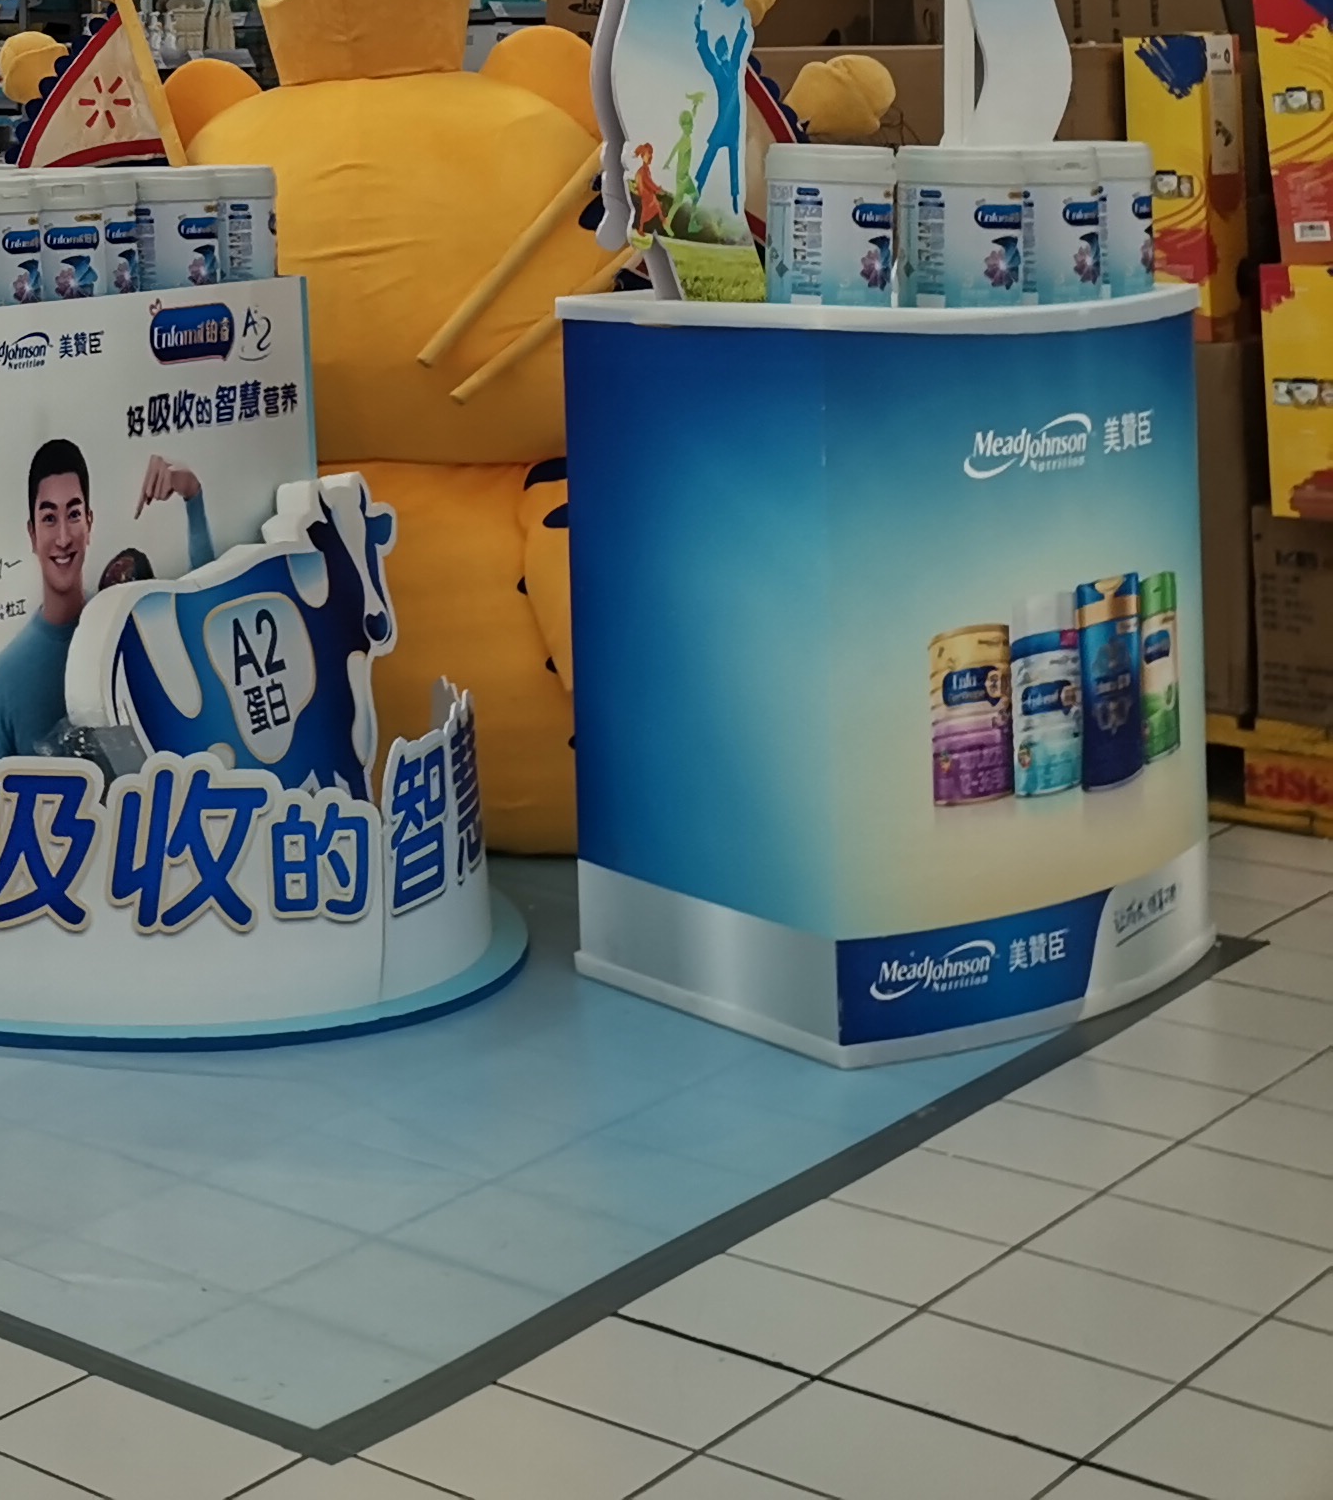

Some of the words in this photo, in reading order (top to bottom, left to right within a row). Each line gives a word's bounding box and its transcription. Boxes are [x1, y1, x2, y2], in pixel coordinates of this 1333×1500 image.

[8, 359, 45, 371] Nutrition
[126, 380, 299, 439] 好吸收的智慧营养
[233, 607, 287, 687] A2
[242, 679, 290, 735] 蛋白
[931, 974, 989, 994] Nutrition
